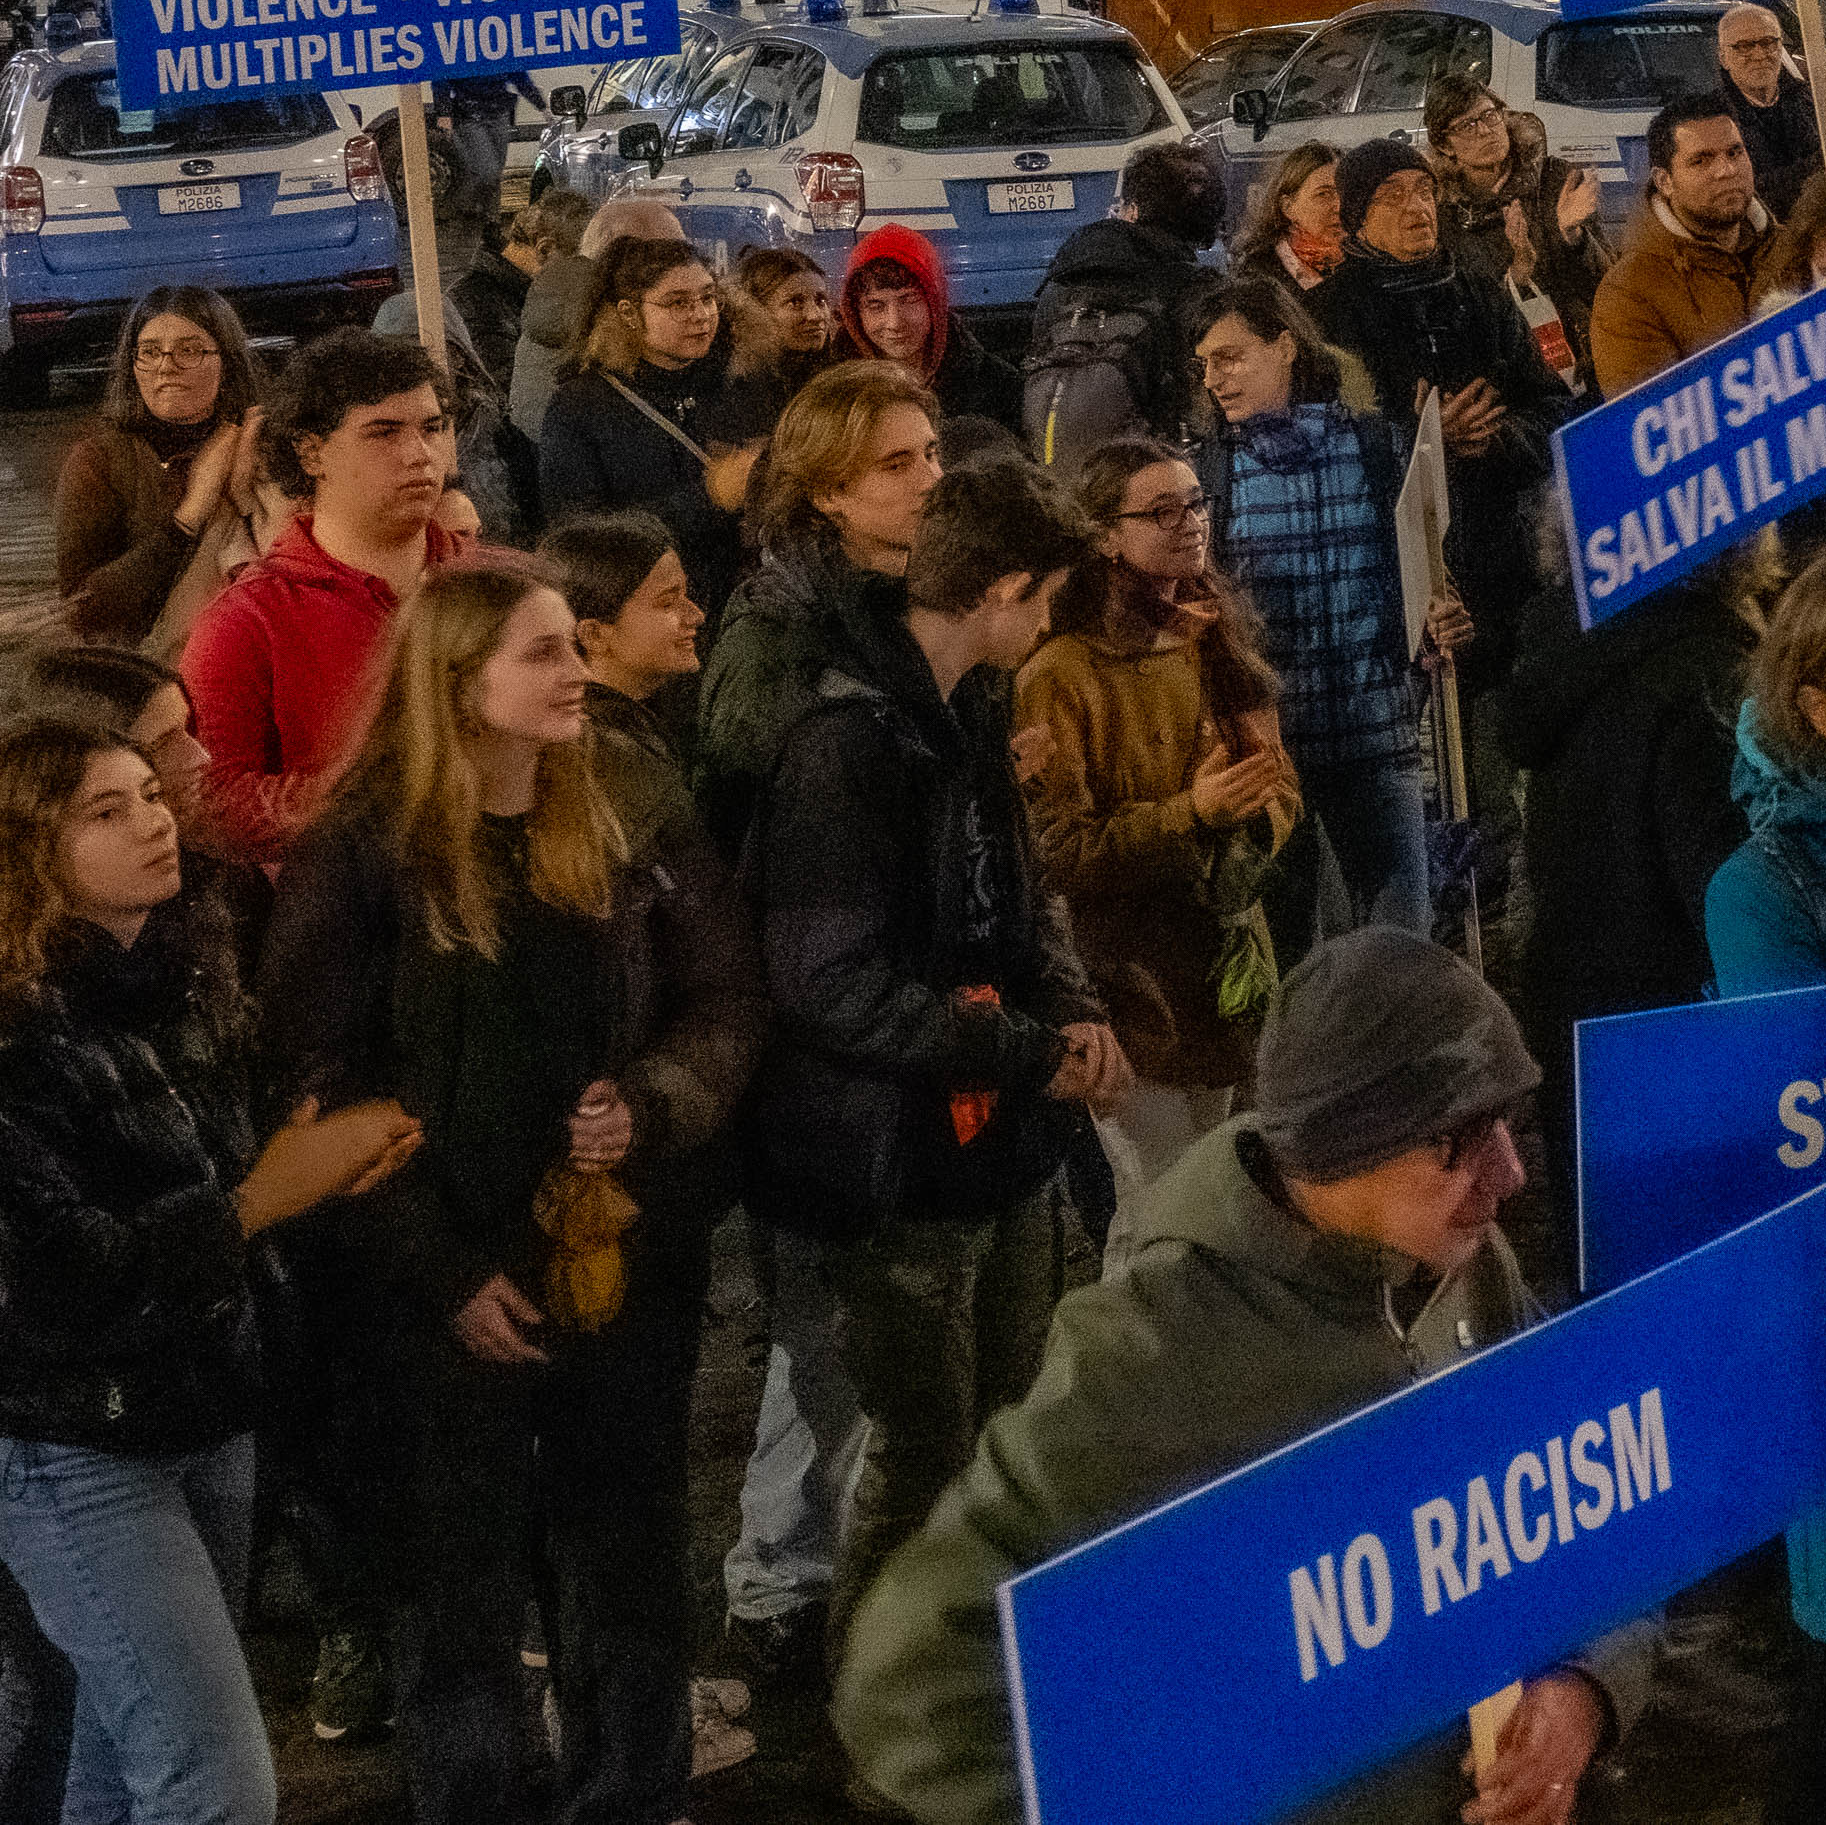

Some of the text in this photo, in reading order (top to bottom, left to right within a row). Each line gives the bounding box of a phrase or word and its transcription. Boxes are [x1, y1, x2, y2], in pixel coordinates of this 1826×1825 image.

[156, 2, 647, 94] MULTIPLIES VIOLENCE
[176, 186, 221, 197] POLIZIA
[178, 196, 223, 211] M2686
[1007, 184, 1053, 194] POLIZIA
[1009, 194, 1055, 212] M2687
[1632, 376, 1719, 477] CHI
[1586, 464, 1735, 599] SALVA
[1736, 437, 1786, 513] IL
[1288, 1387, 1673, 1684] NO RACISM
